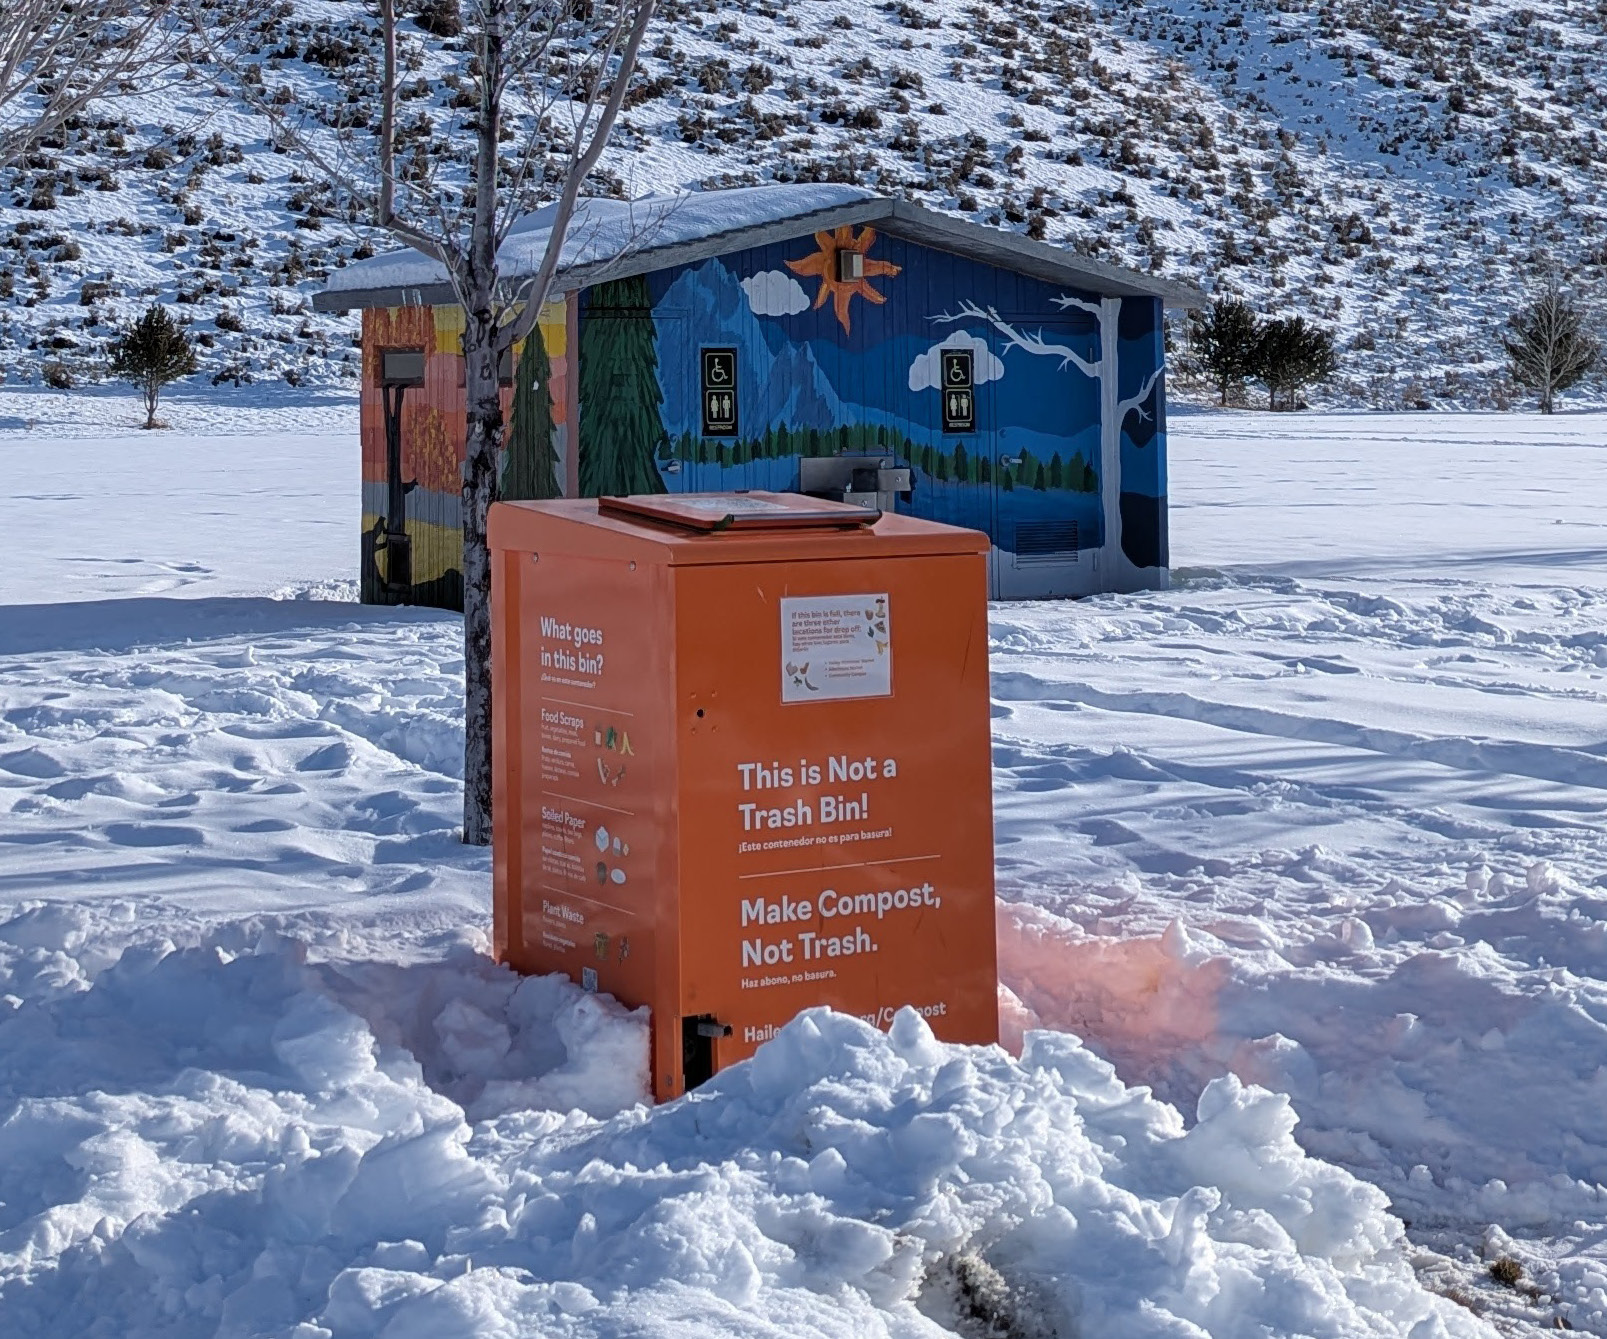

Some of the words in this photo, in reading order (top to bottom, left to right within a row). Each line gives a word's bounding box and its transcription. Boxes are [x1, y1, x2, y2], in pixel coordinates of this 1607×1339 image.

[798, 611, 810, 619] this
[811, 611, 822, 619] bin
[823, 610, 829, 618] is
[830, 610, 843, 618] full,
[823, 619, 840, 627] other
[541, 616, 571, 640] What
[574, 627, 603, 648] goes
[834, 626, 850, 635] drop
[541, 646, 551, 667] in
[554, 648, 575, 671] this
[578, 651, 604, 675] bin?
[541, 708, 558, 723] Food
[560, 711, 584, 730] Scraps
[737, 761, 794, 790] This
[800, 758, 821, 785] is
[828, 755, 877, 782] Not
[882, 757, 897, 777] a
[542, 806, 563, 823] Soiled
[565, 812, 586, 833] Paper
[738, 798, 813, 831] Trash
[820, 792, 868, 823] Bin!
[763, 837, 814, 851] contenedor
[815, 835, 827, 844] no
[828, 834, 838, 843] es
[839, 832, 860, 845] para
[860, 827, 893, 839] basura!
[543, 900, 561, 917] Plant
[561, 905, 584, 925] Waste
[741, 895, 812, 927] Make
[818, 882, 941, 919] Compost,
[742, 938, 793, 967] Not
[798, 926, 878, 960] Trash.
[741, 978, 759, 989] Haz
[760, 974, 790, 988] abono,
[791, 973, 803, 983] no
[804, 969, 837, 981] basura.
[744, 1024, 781, 1043] Haile
